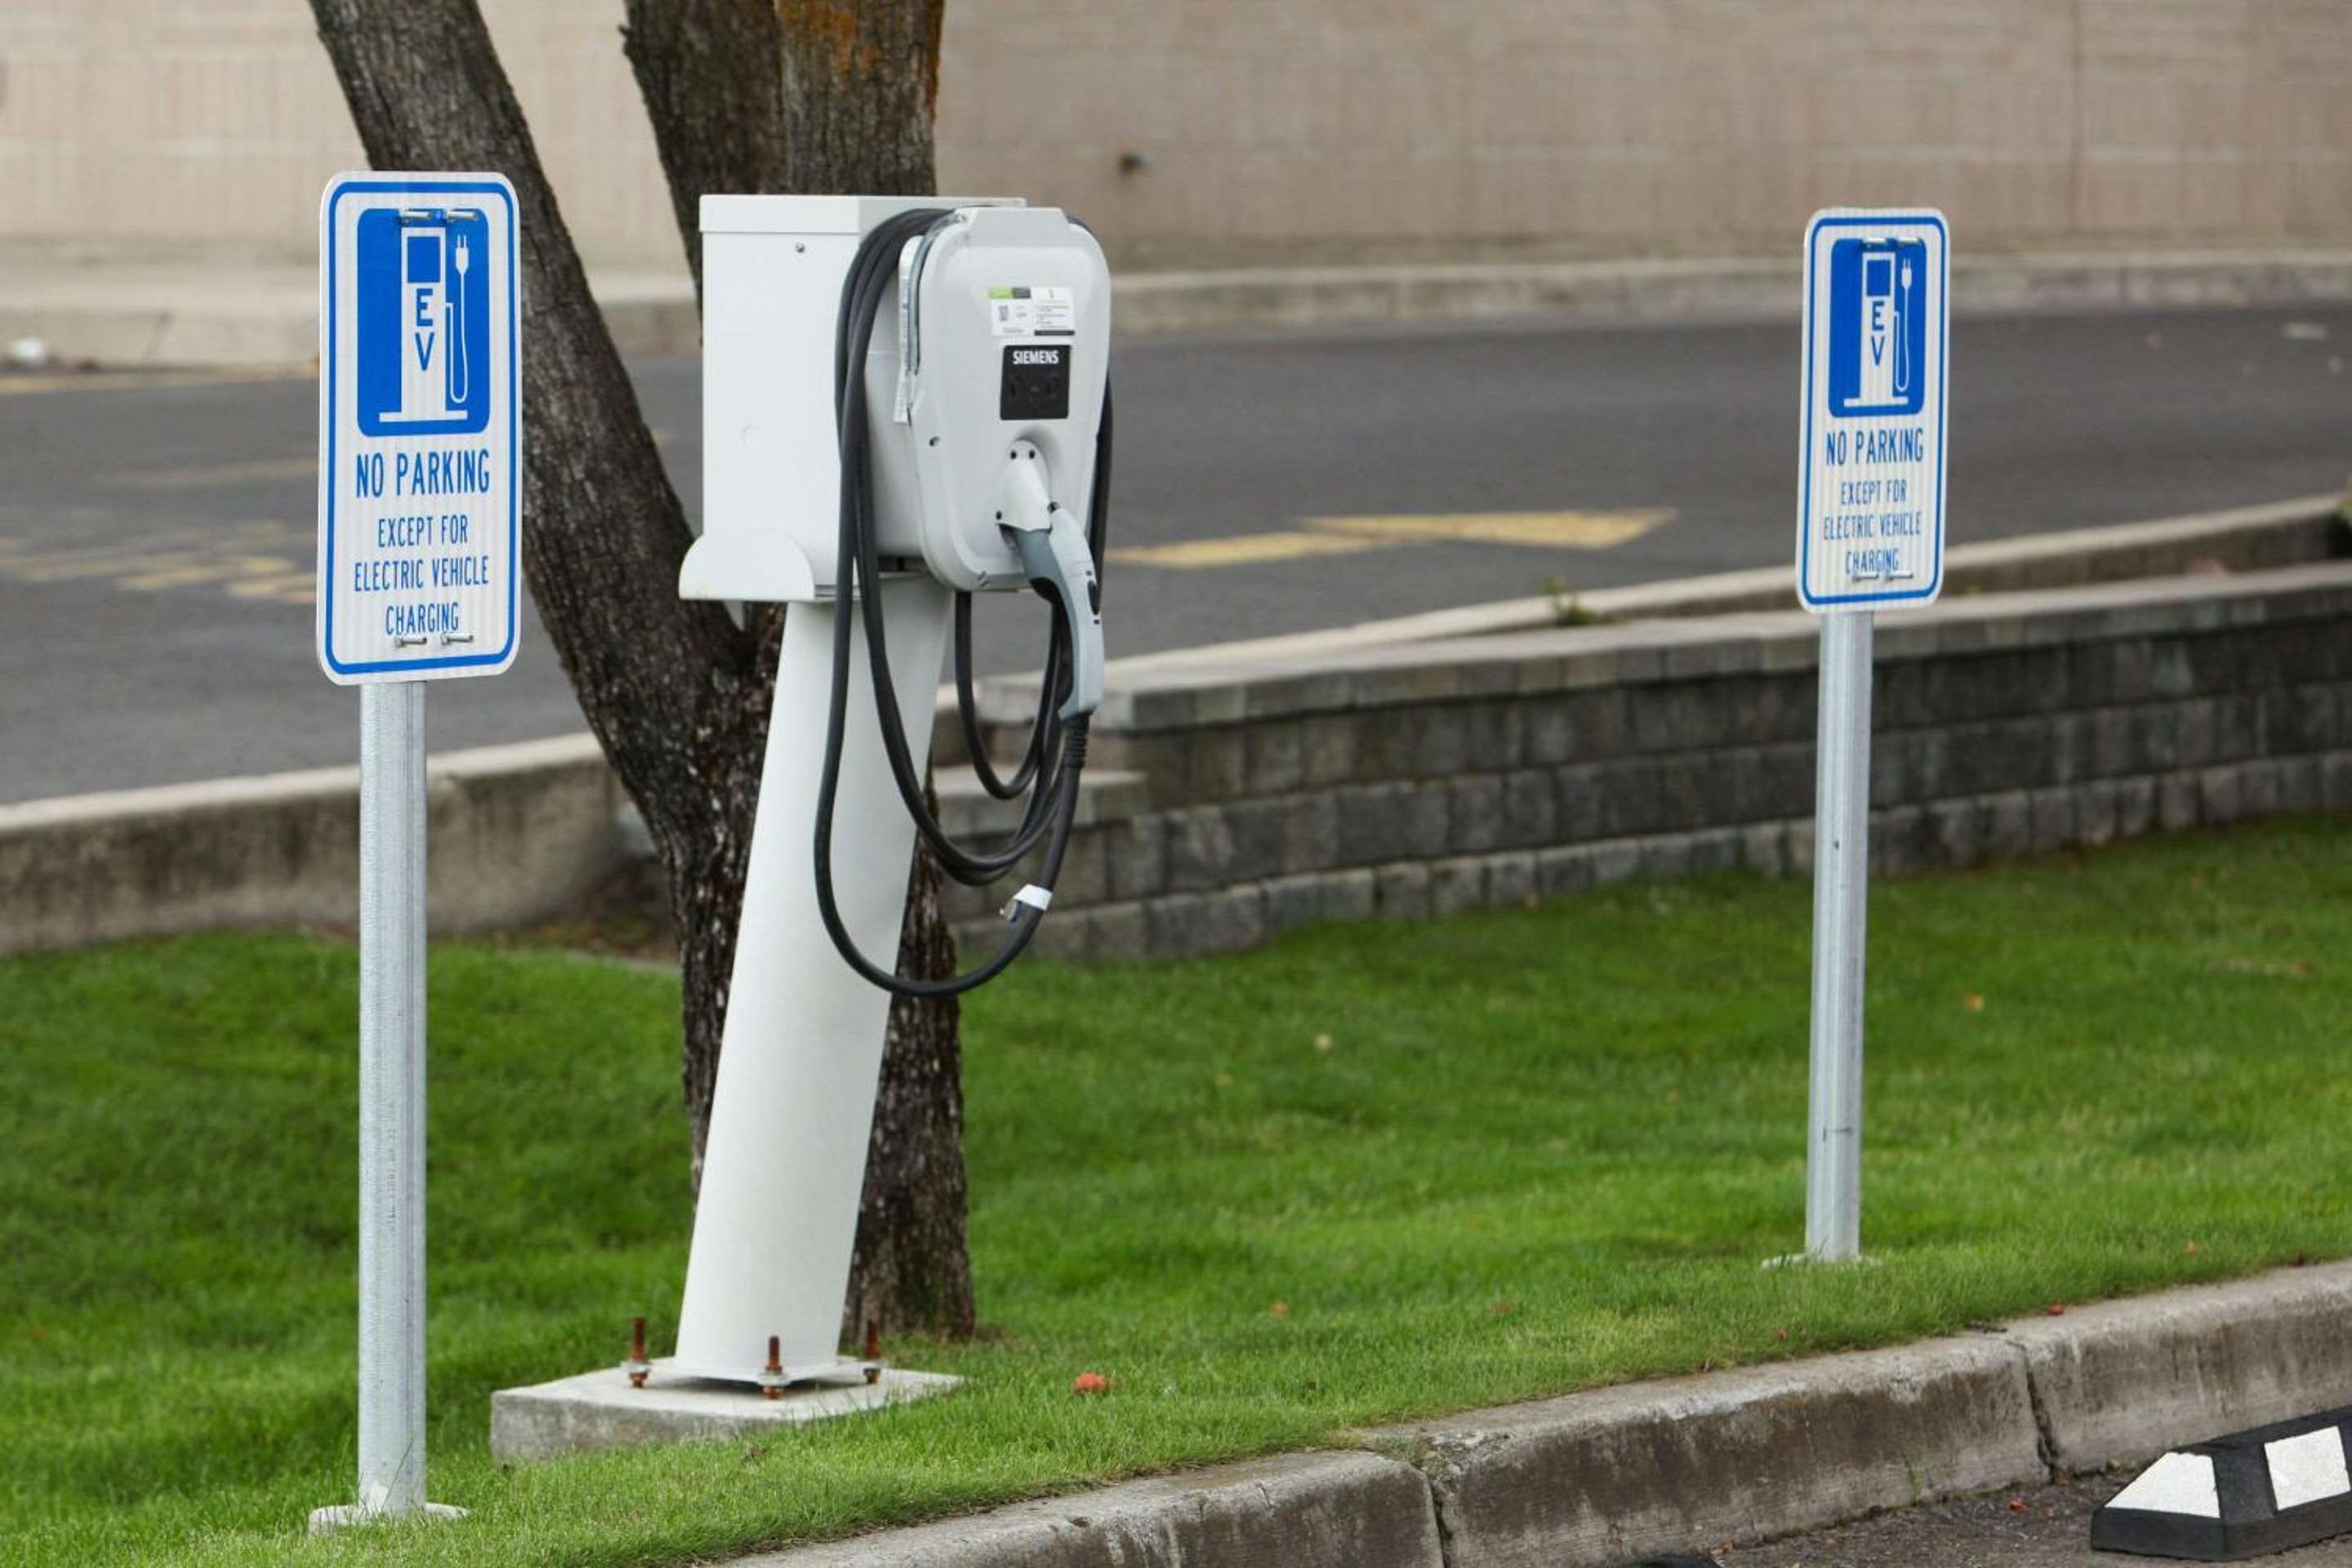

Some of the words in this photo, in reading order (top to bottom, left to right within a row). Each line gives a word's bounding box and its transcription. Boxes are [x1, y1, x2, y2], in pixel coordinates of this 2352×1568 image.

[416, 287, 434, 371] EV
[1870, 301, 1885, 366] EV
[1013, 350, 1059, 364] SIEMENS
[1826, 430, 1846, 466] NO
[1855, 427, 1924, 463] PARKING
[356, 452, 384, 497] NO
[396, 449, 490, 495] PARKING
[1841, 481, 1882, 506] EXCEPT
[1886, 480, 1907, 503] FOR
[378, 516, 433, 547] EXCEPT
[441, 514, 468, 544] FOR
[1824, 514, 1875, 540] ELECTRIC
[1880, 512, 1921, 537] VEHICLE
[354, 559, 424, 592] ELECTRIC
[433, 555, 489, 587] VEHICLE
[1846, 548, 1899, 574] CHARGING
[385, 602, 459, 635] CHARGING
